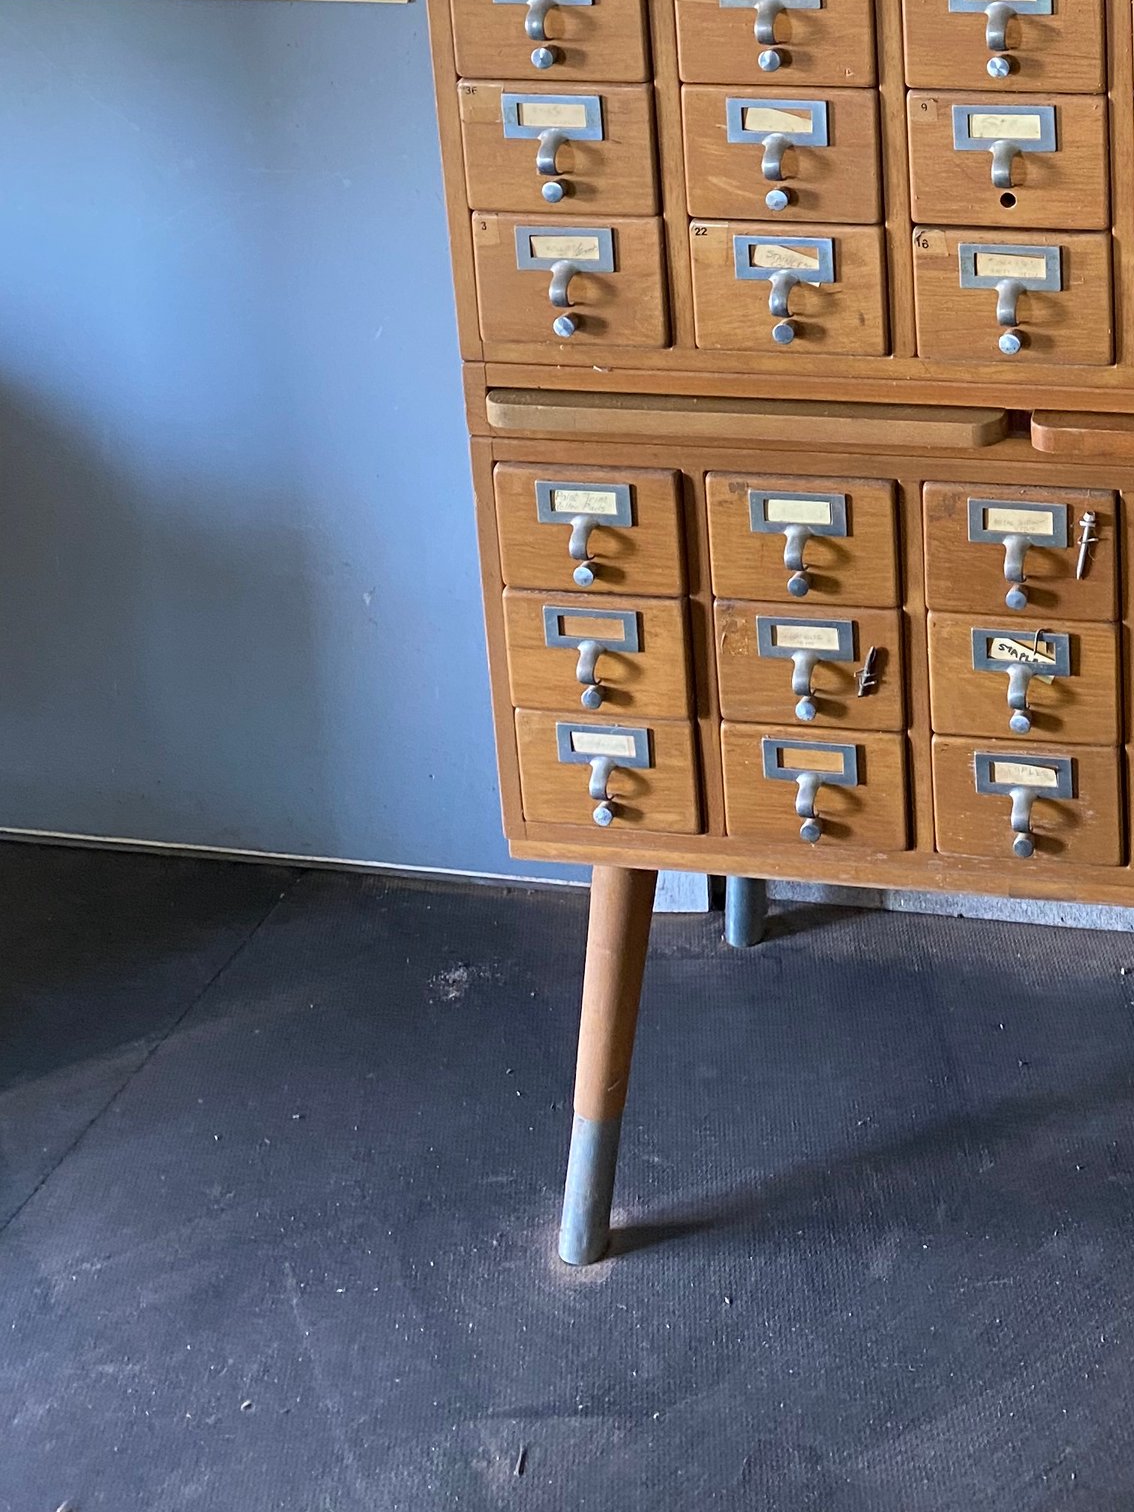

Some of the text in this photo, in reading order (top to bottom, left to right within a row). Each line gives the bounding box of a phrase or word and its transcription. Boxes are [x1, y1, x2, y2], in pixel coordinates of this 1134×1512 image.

[921, 103, 928, 112] 9
[481, 222, 487, 230] 3
[694, 228, 708, 236] 22
